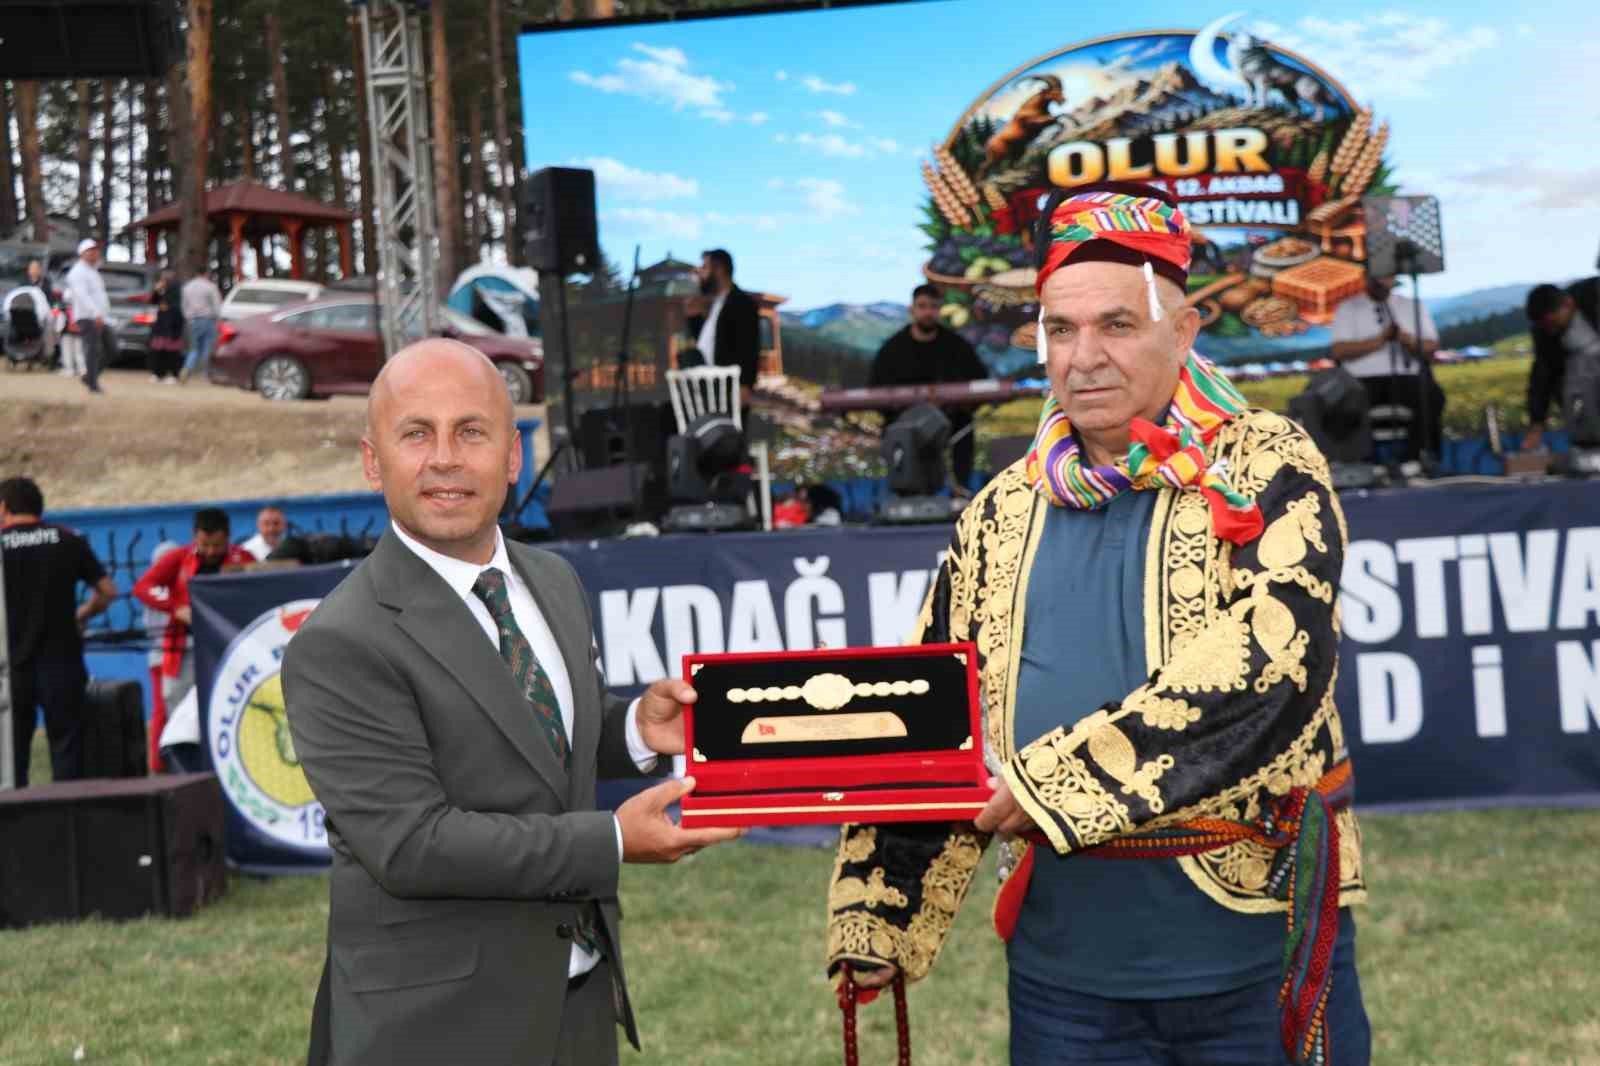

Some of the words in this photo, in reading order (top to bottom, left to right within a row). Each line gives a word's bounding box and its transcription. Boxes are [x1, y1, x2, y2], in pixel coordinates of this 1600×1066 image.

[1048, 128, 1271, 188] OLUR
[600, 556, 847, 686] KDAĞ
[1341, 527, 1600, 643] STİVA
[219, 665, 259, 758] OLUR
[300, 808, 326, 840] 19
